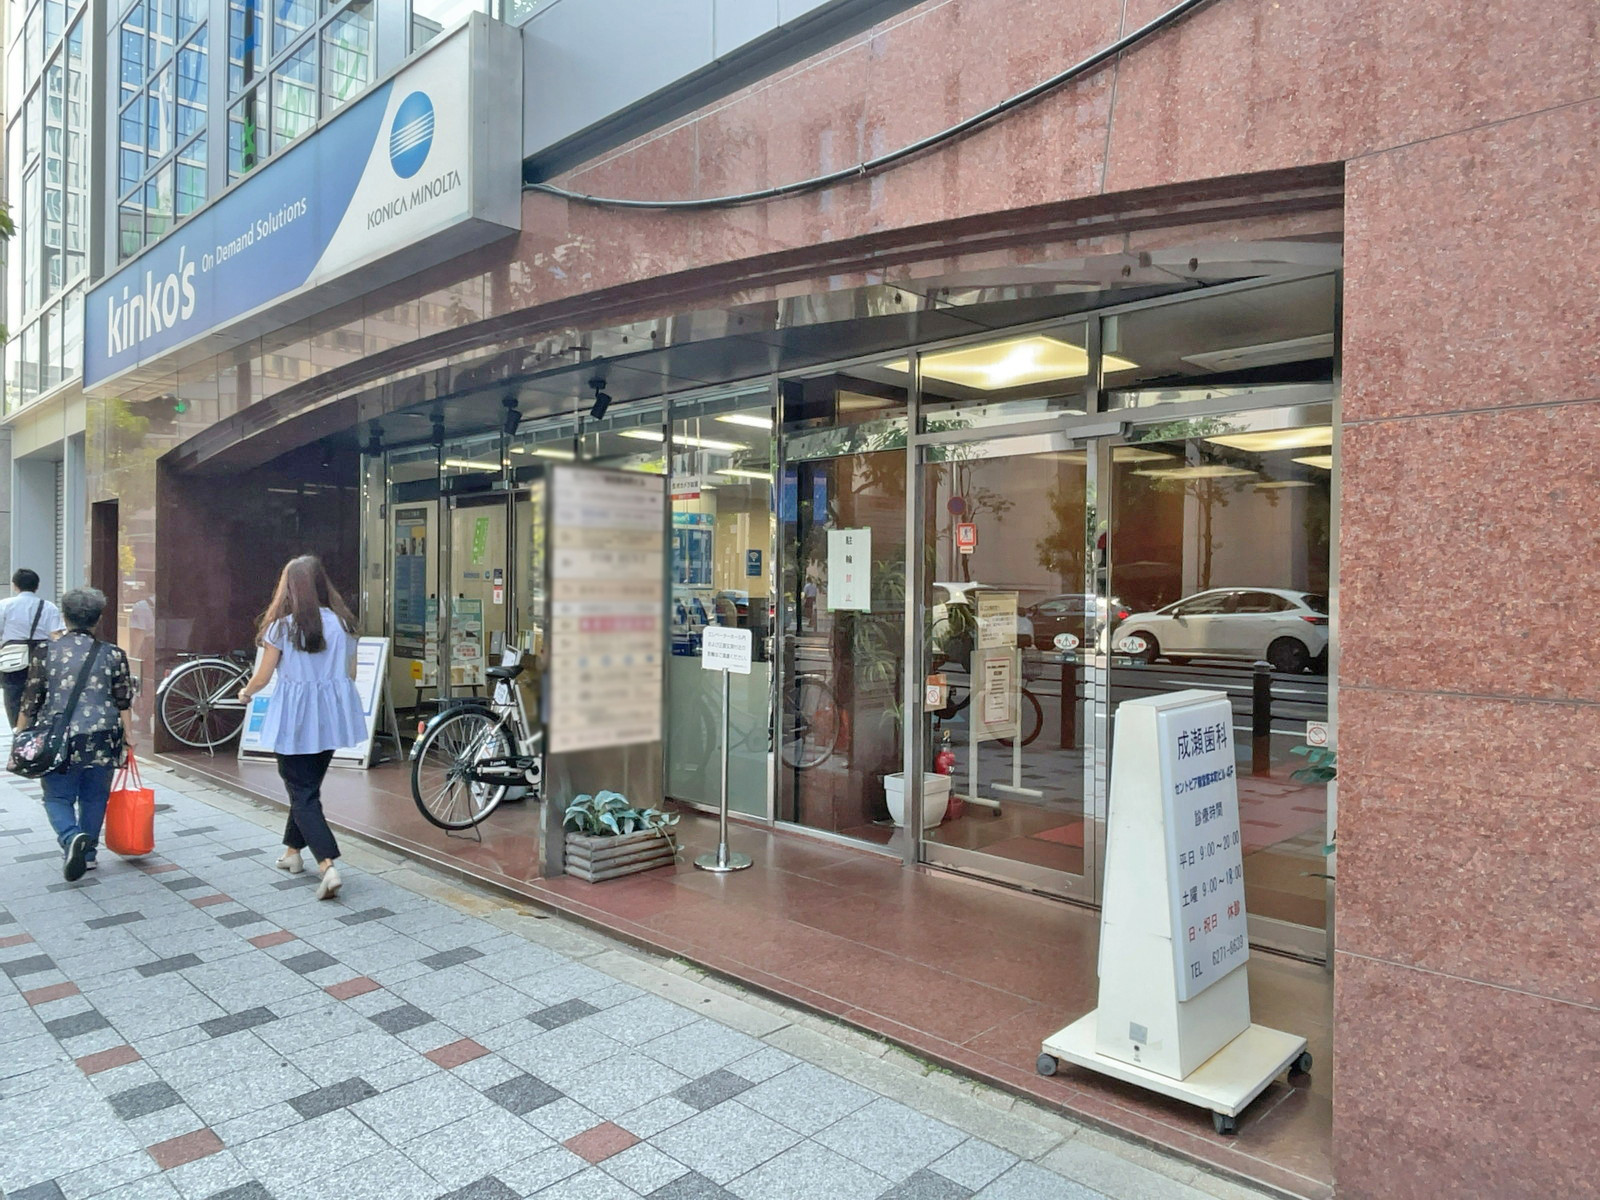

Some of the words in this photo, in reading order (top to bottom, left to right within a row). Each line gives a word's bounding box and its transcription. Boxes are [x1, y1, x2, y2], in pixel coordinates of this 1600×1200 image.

[367, 196, 408, 230] KONICA
[410, 169, 461, 210] MINOLTA
[202, 253, 214, 272] On
[216, 223, 254, 265] Demand
[256, 197, 307, 241] Solutions
[107, 245, 196, 358] kinko's
[1177, 721, 1227, 760] 成瀬歯科
[1194, 801, 1223, 827] 診療時間
[1179, 850, 1195, 870] 平日
[1182, 885, 1198, 908] 土曜
[1188, 913, 1217, 942] 日・祝日
[1227, 899, 1240, 920] 休診
[1190, 961, 1203, 980] TEL
